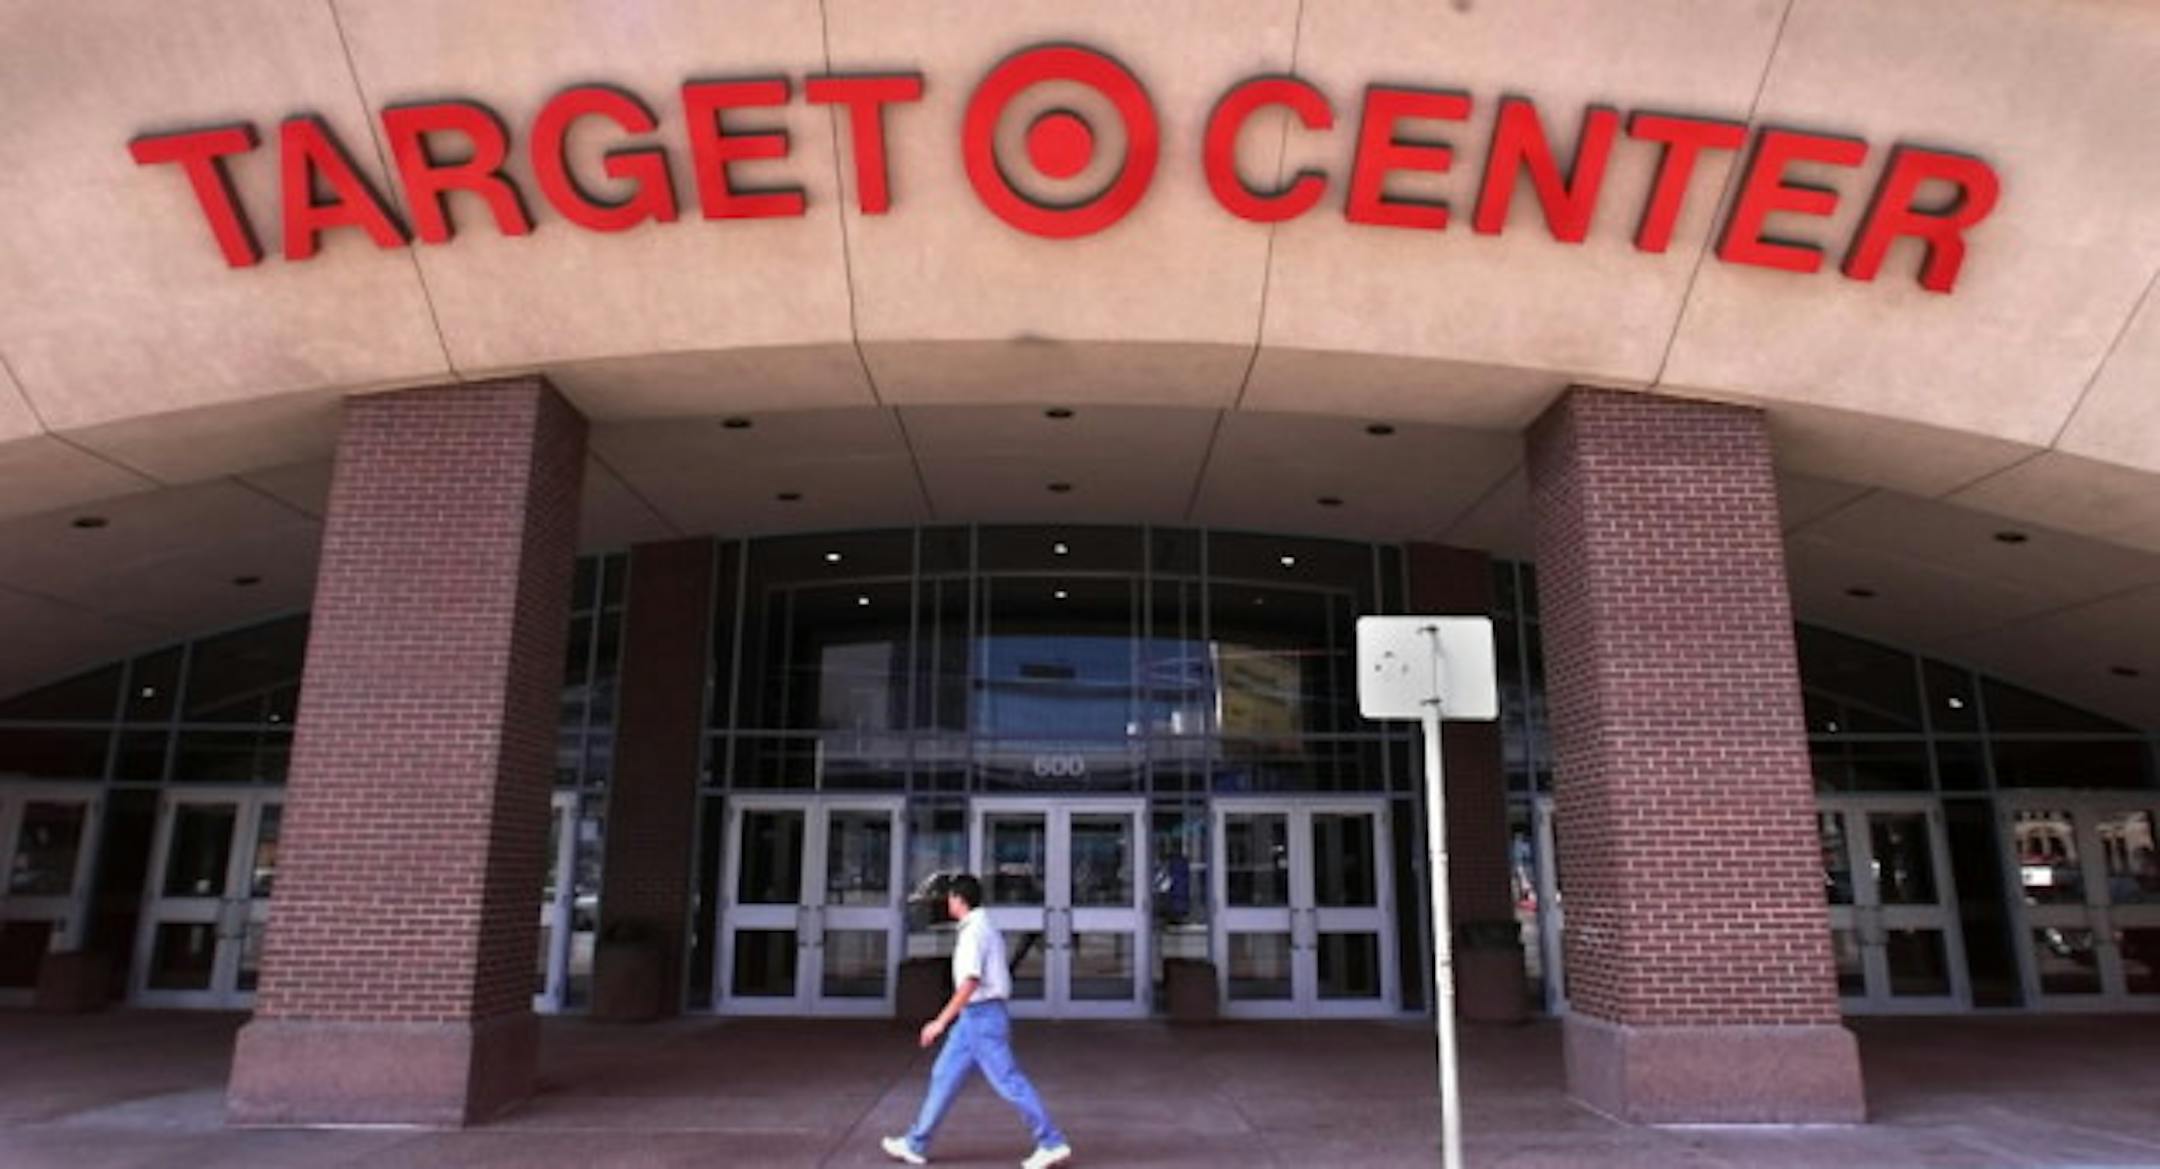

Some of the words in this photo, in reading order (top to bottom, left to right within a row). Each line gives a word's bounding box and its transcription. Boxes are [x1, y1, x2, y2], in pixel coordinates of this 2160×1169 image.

[128, 73, 924, 270] TARGET
[1202, 77, 2002, 296] CENTER
[1033, 753, 1085, 777] 600
